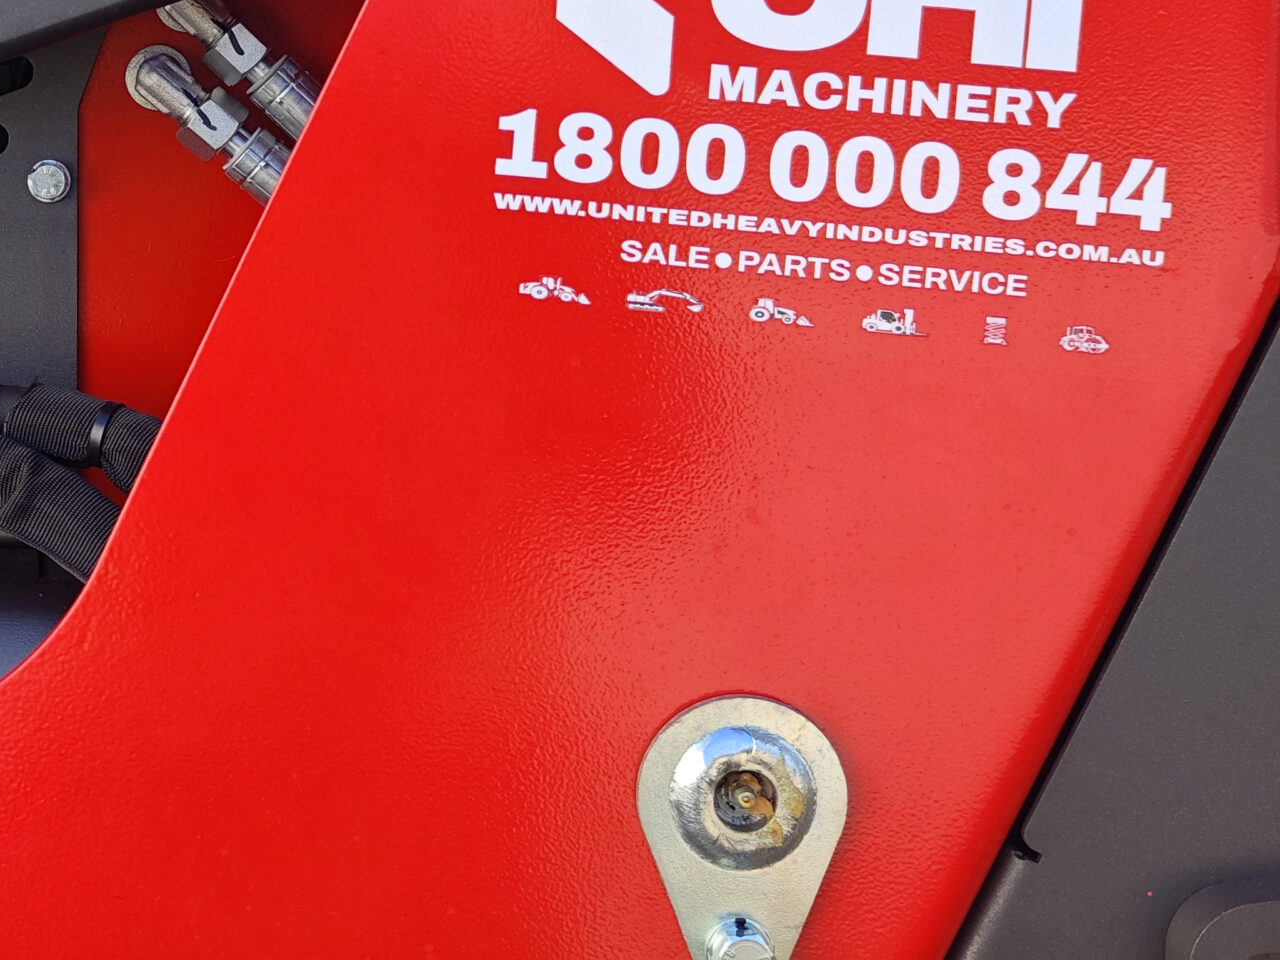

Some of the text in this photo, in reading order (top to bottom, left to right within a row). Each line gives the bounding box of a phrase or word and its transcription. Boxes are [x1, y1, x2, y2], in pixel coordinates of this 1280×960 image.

[708, 63, 1077, 129] MACHINERY
[494, 108, 1173, 232] 1800 000 844
[493, 192, 1165, 267] WWW.UNITEDHEAVYINDUSTRIES.COM.AU
[620, 239, 1028, 297] SALE PARTS SERVICE
